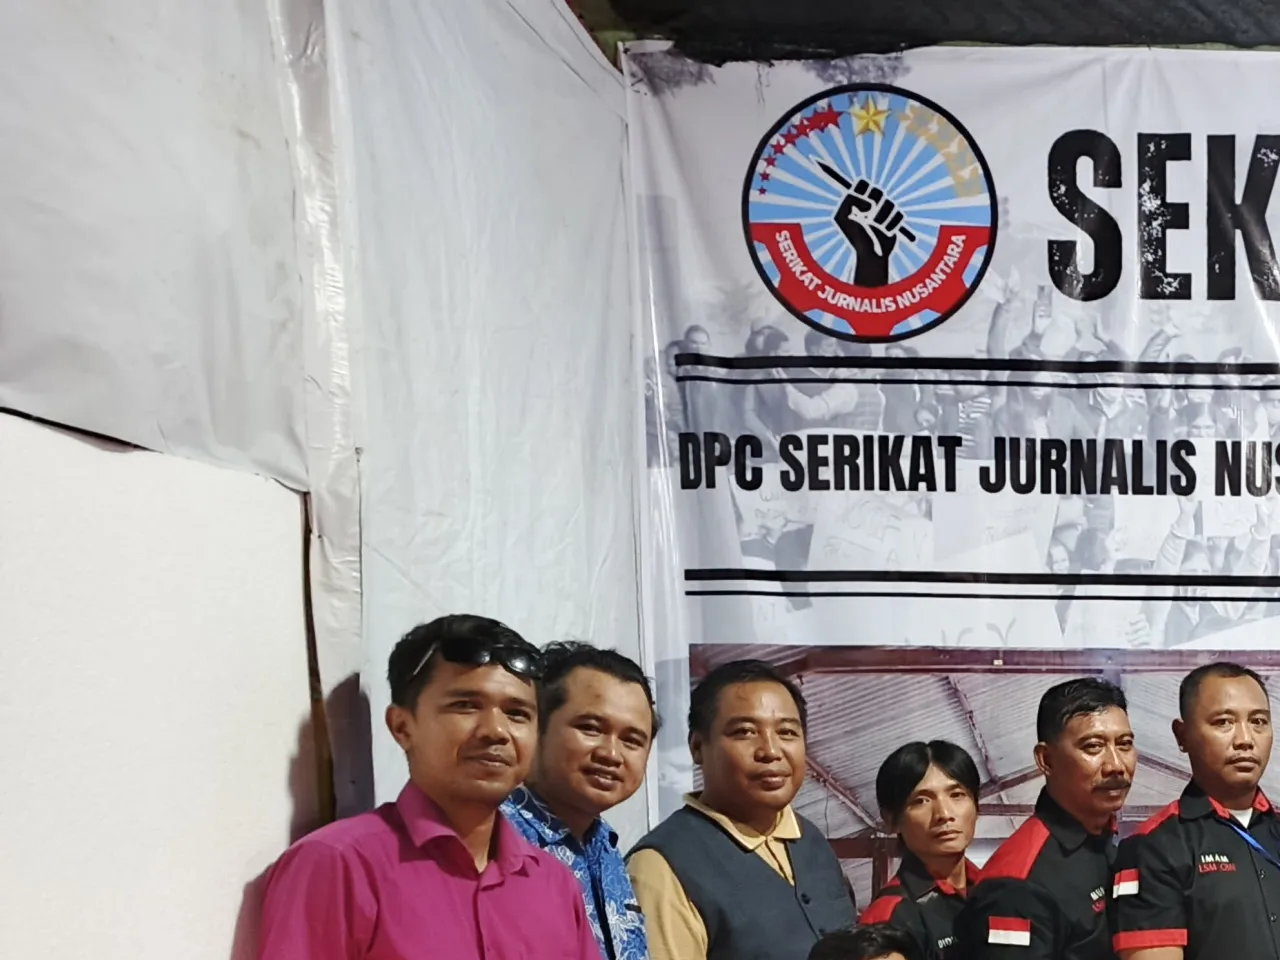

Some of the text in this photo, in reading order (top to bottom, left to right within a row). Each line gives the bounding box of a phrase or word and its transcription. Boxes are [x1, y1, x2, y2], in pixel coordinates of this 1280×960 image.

[775, 230, 966, 313] SERIKAT JURNALIS NUSANTARA
[679, 433, 763, 490] DPC
[779, 434, 963, 492] SERIKAT
[980, 438, 1196, 496] JURNALIS
